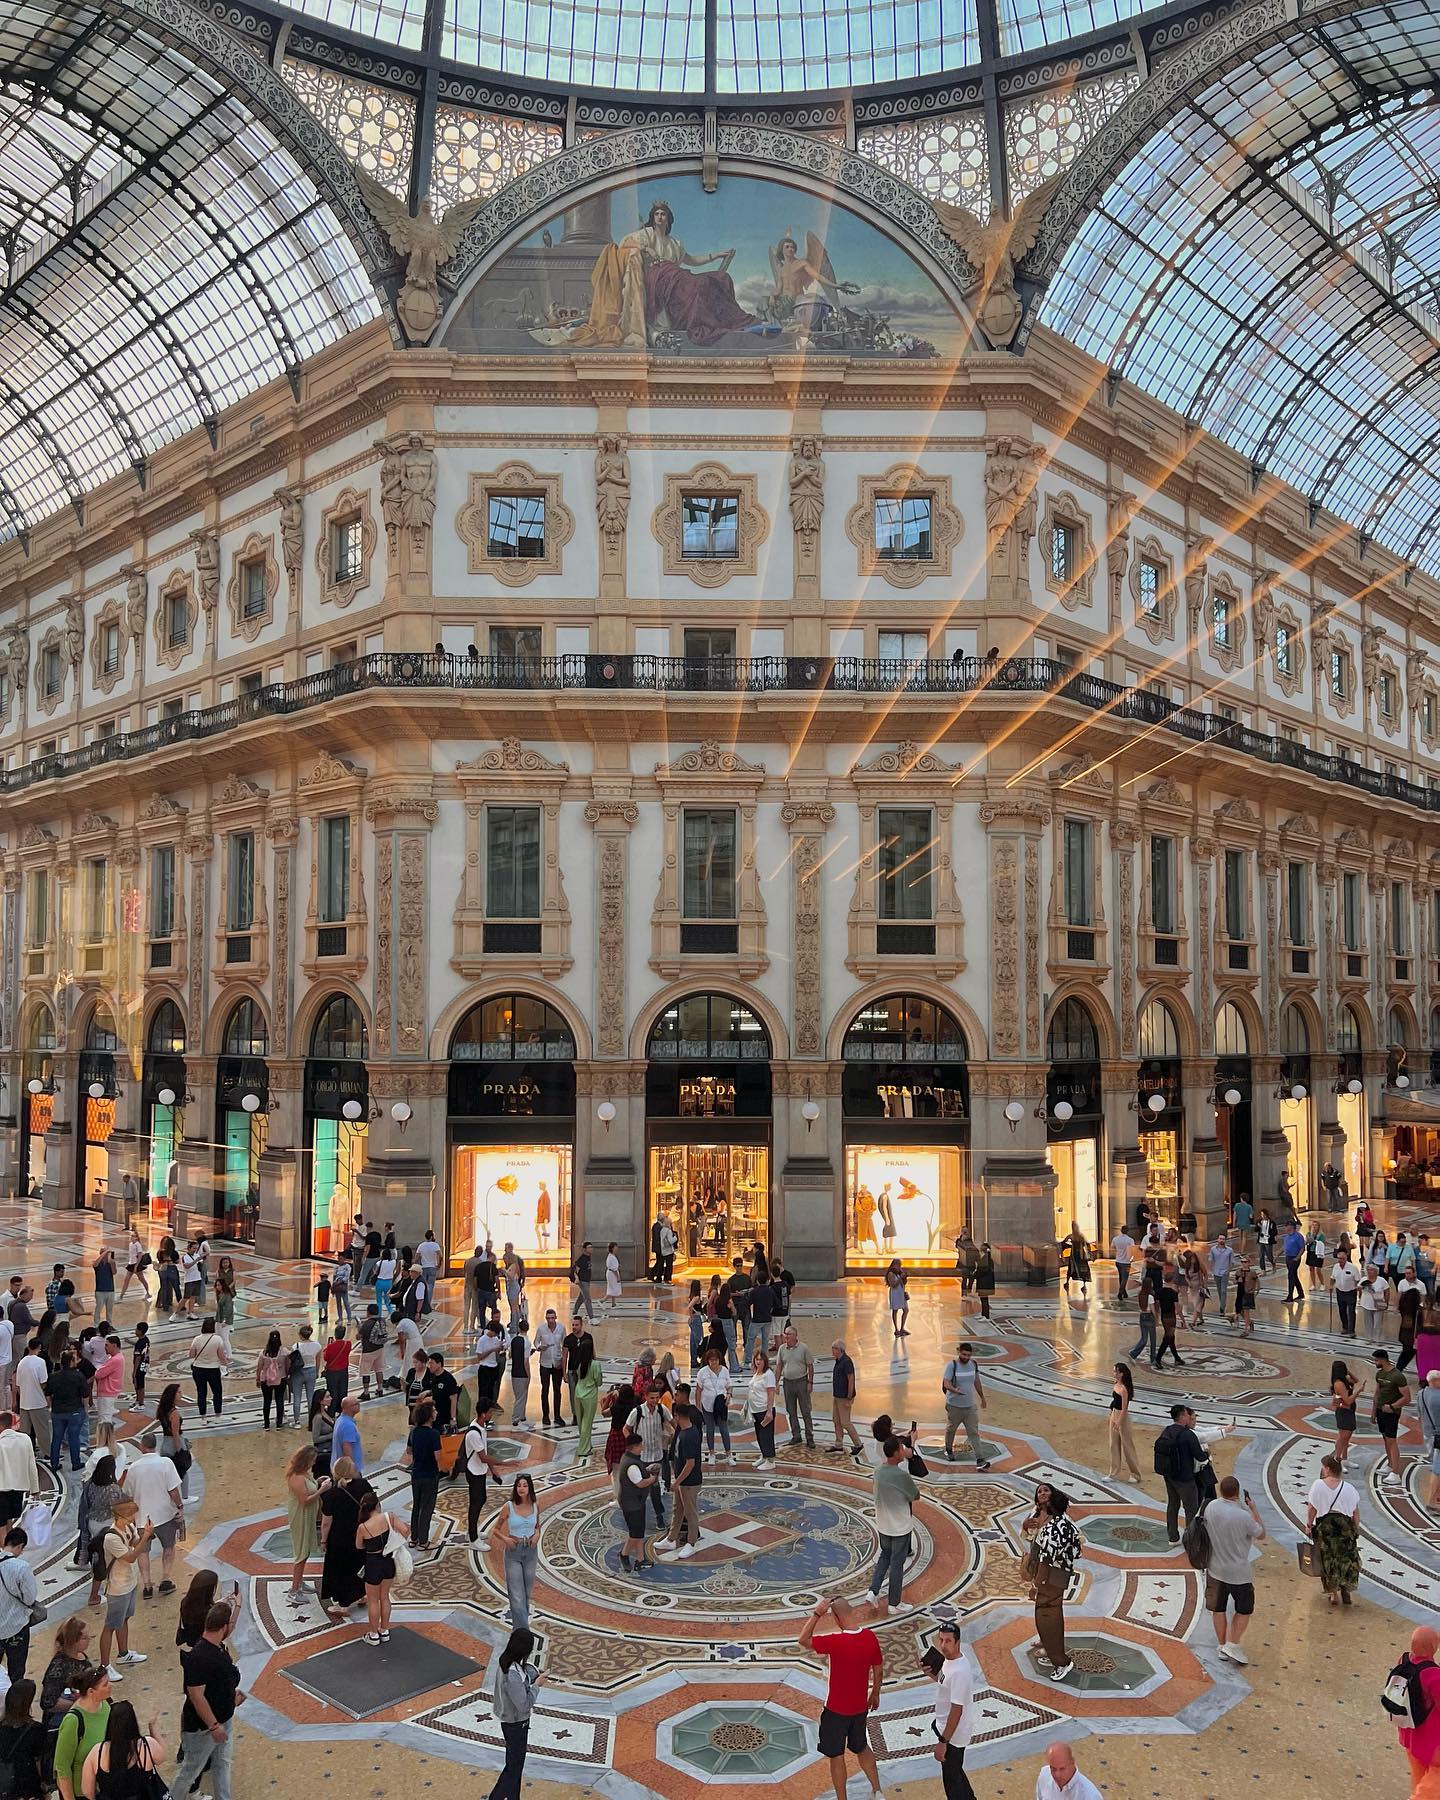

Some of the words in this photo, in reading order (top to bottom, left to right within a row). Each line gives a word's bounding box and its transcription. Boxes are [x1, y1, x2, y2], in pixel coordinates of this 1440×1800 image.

[483, 1084, 541, 1095] PRADA
[680, 1085, 737, 1095] PRADA
[876, 1085, 935, 1096] PRADA
[1056, 1084, 1086, 1095] PRADA
